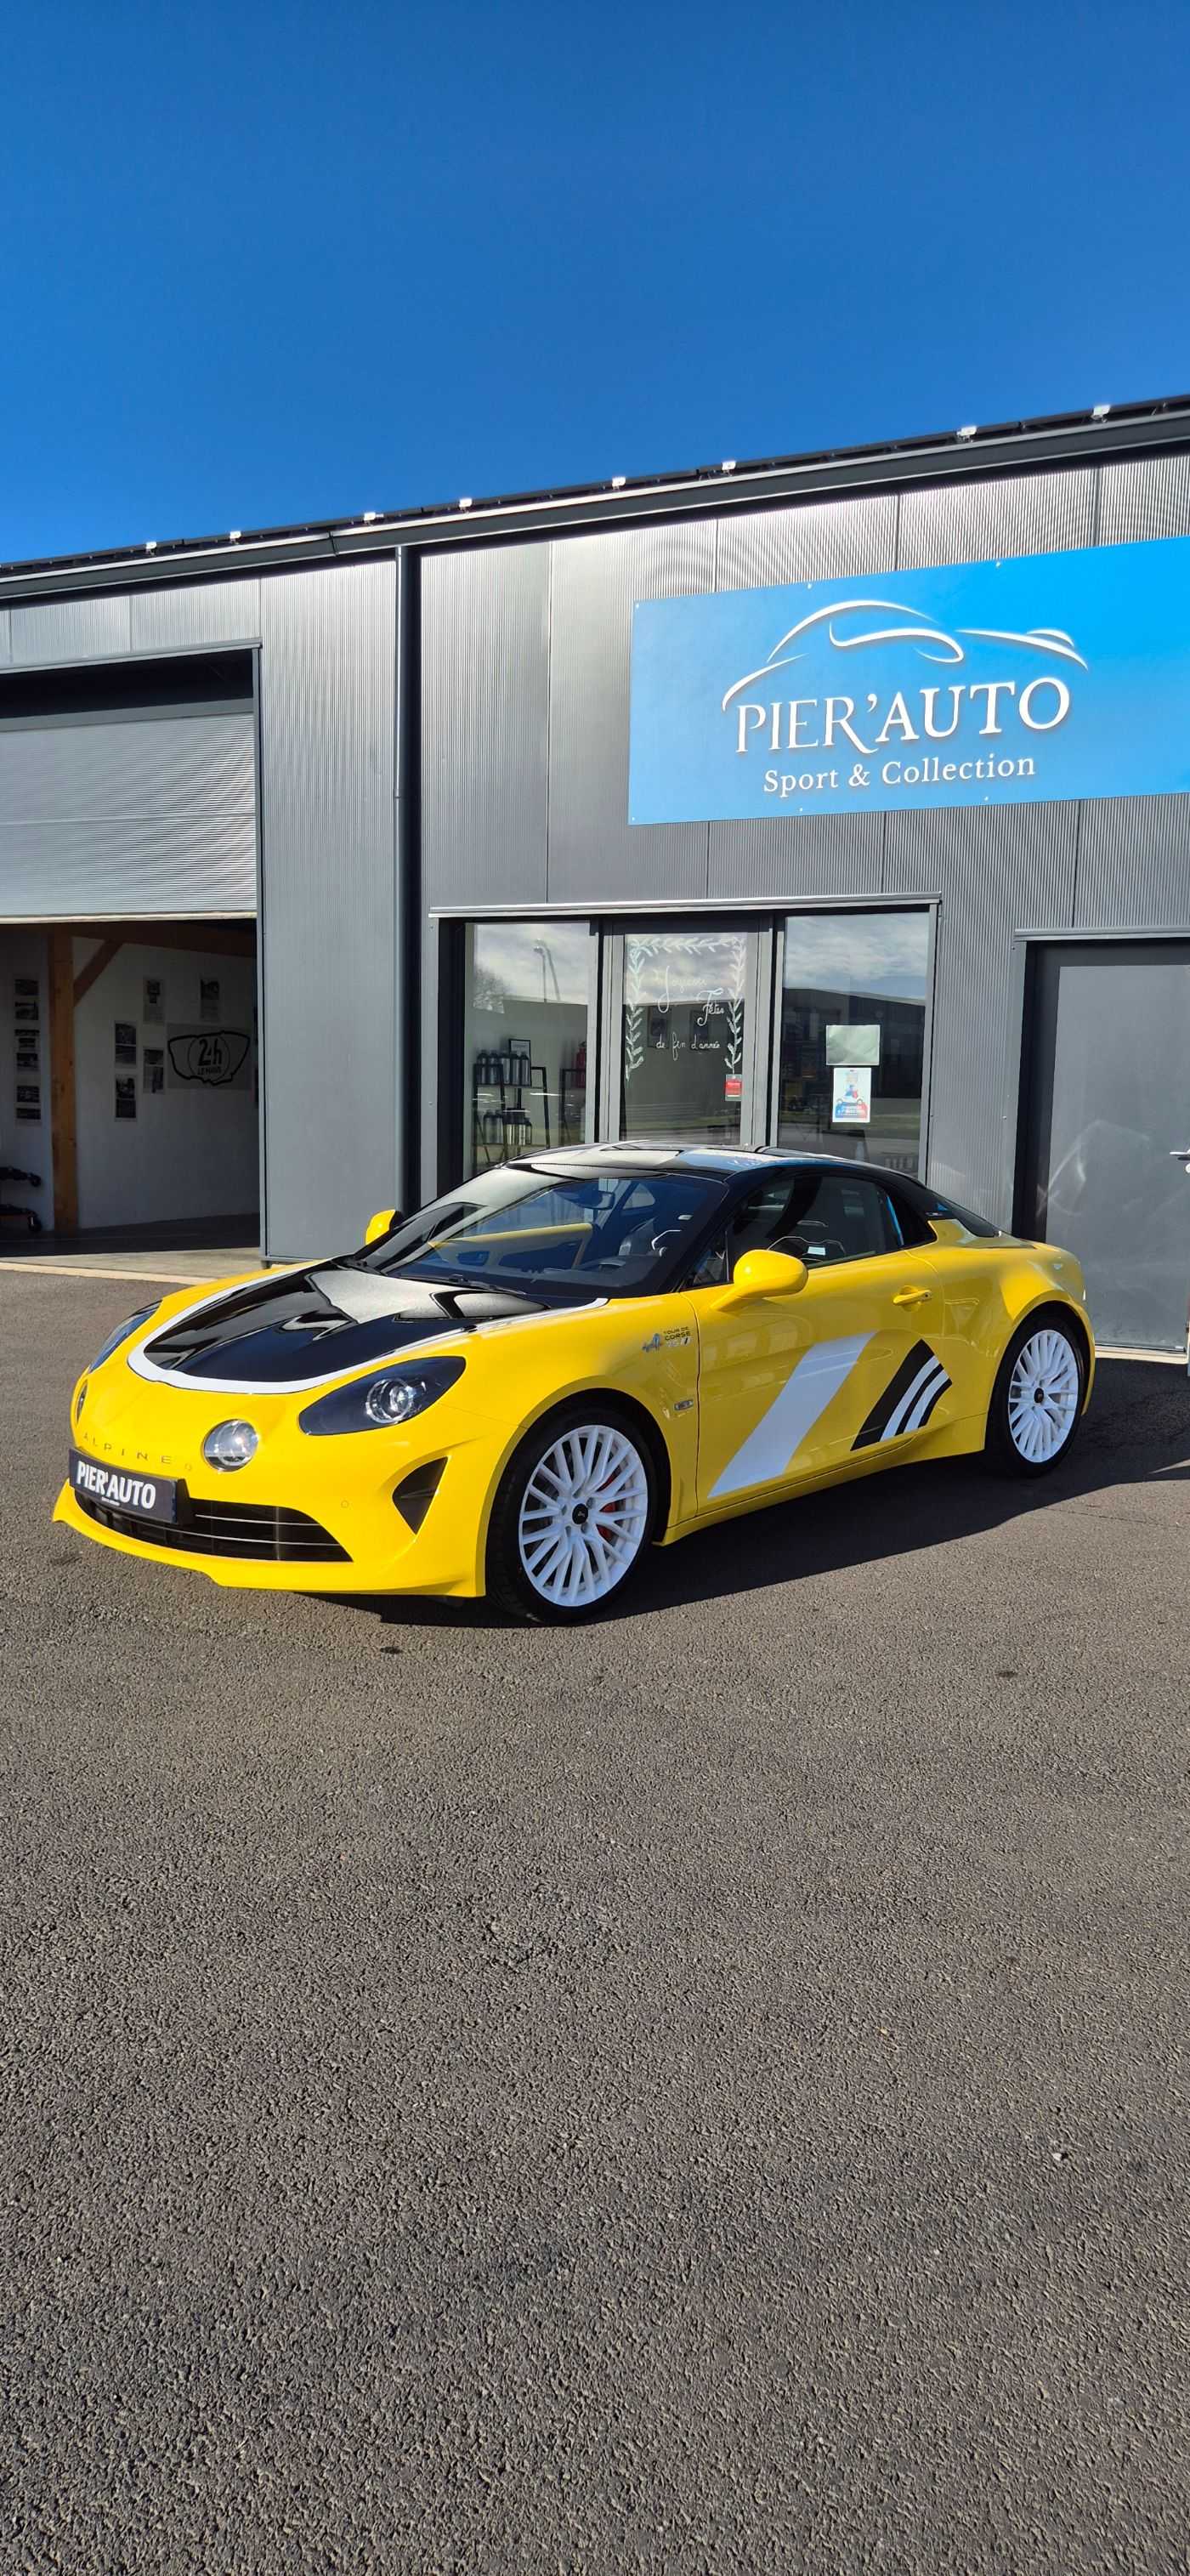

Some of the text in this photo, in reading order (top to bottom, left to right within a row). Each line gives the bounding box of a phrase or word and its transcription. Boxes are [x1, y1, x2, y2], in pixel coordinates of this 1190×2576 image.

[735, 677, 1070, 755] PIER'AUTO
[763, 754, 1035, 797] Sport & Collection
[83, 1433, 172, 1464] ALPINE
[76, 1461, 156, 1509] PIER'AUTO
